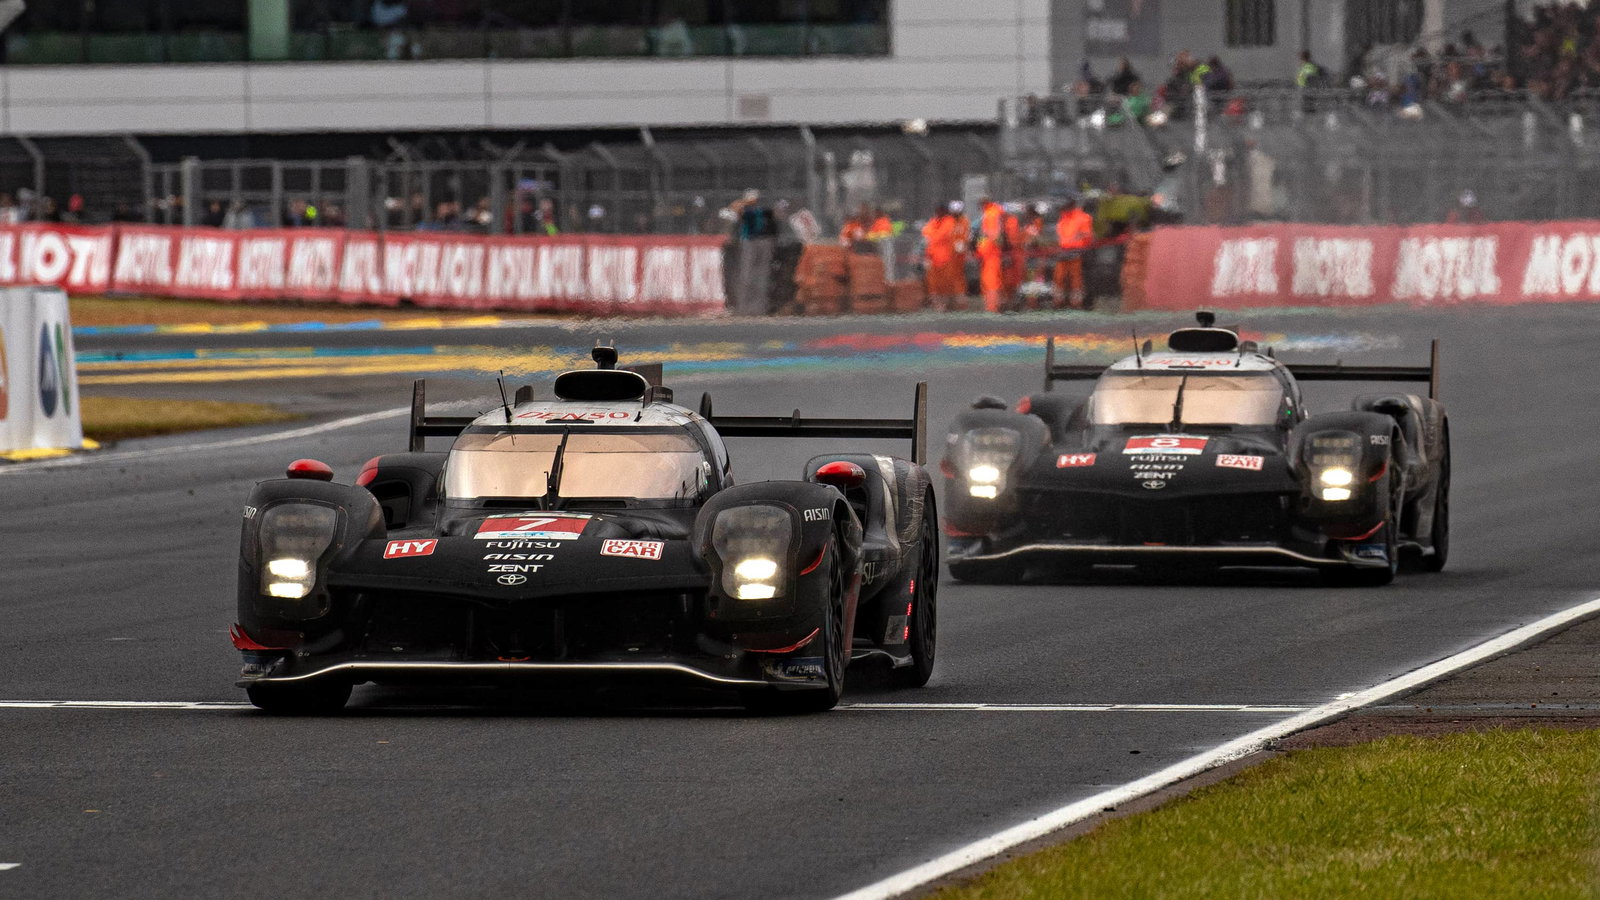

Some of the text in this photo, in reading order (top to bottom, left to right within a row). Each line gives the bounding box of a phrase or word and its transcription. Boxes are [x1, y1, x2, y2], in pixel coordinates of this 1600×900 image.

[1391, 235, 1501, 299] MOTUL
[517, 411, 629, 421] DENSO
[1151, 438, 1180, 447] 8
[1060, 455, 1093, 465] HY
[1221, 459, 1258, 468] CAR
[1133, 471, 1176, 479] ZENT
[804, 507, 830, 522] AISIN
[513, 517, 558, 531] 7
[388, 540, 433, 555] HY
[485, 541, 561, 550] FUJITSU
[608, 540, 658, 548] HYPER
[607, 545, 656, 557] CAR
[482, 553, 555, 561] AISIN
[487, 564, 544, 573] ZENT
